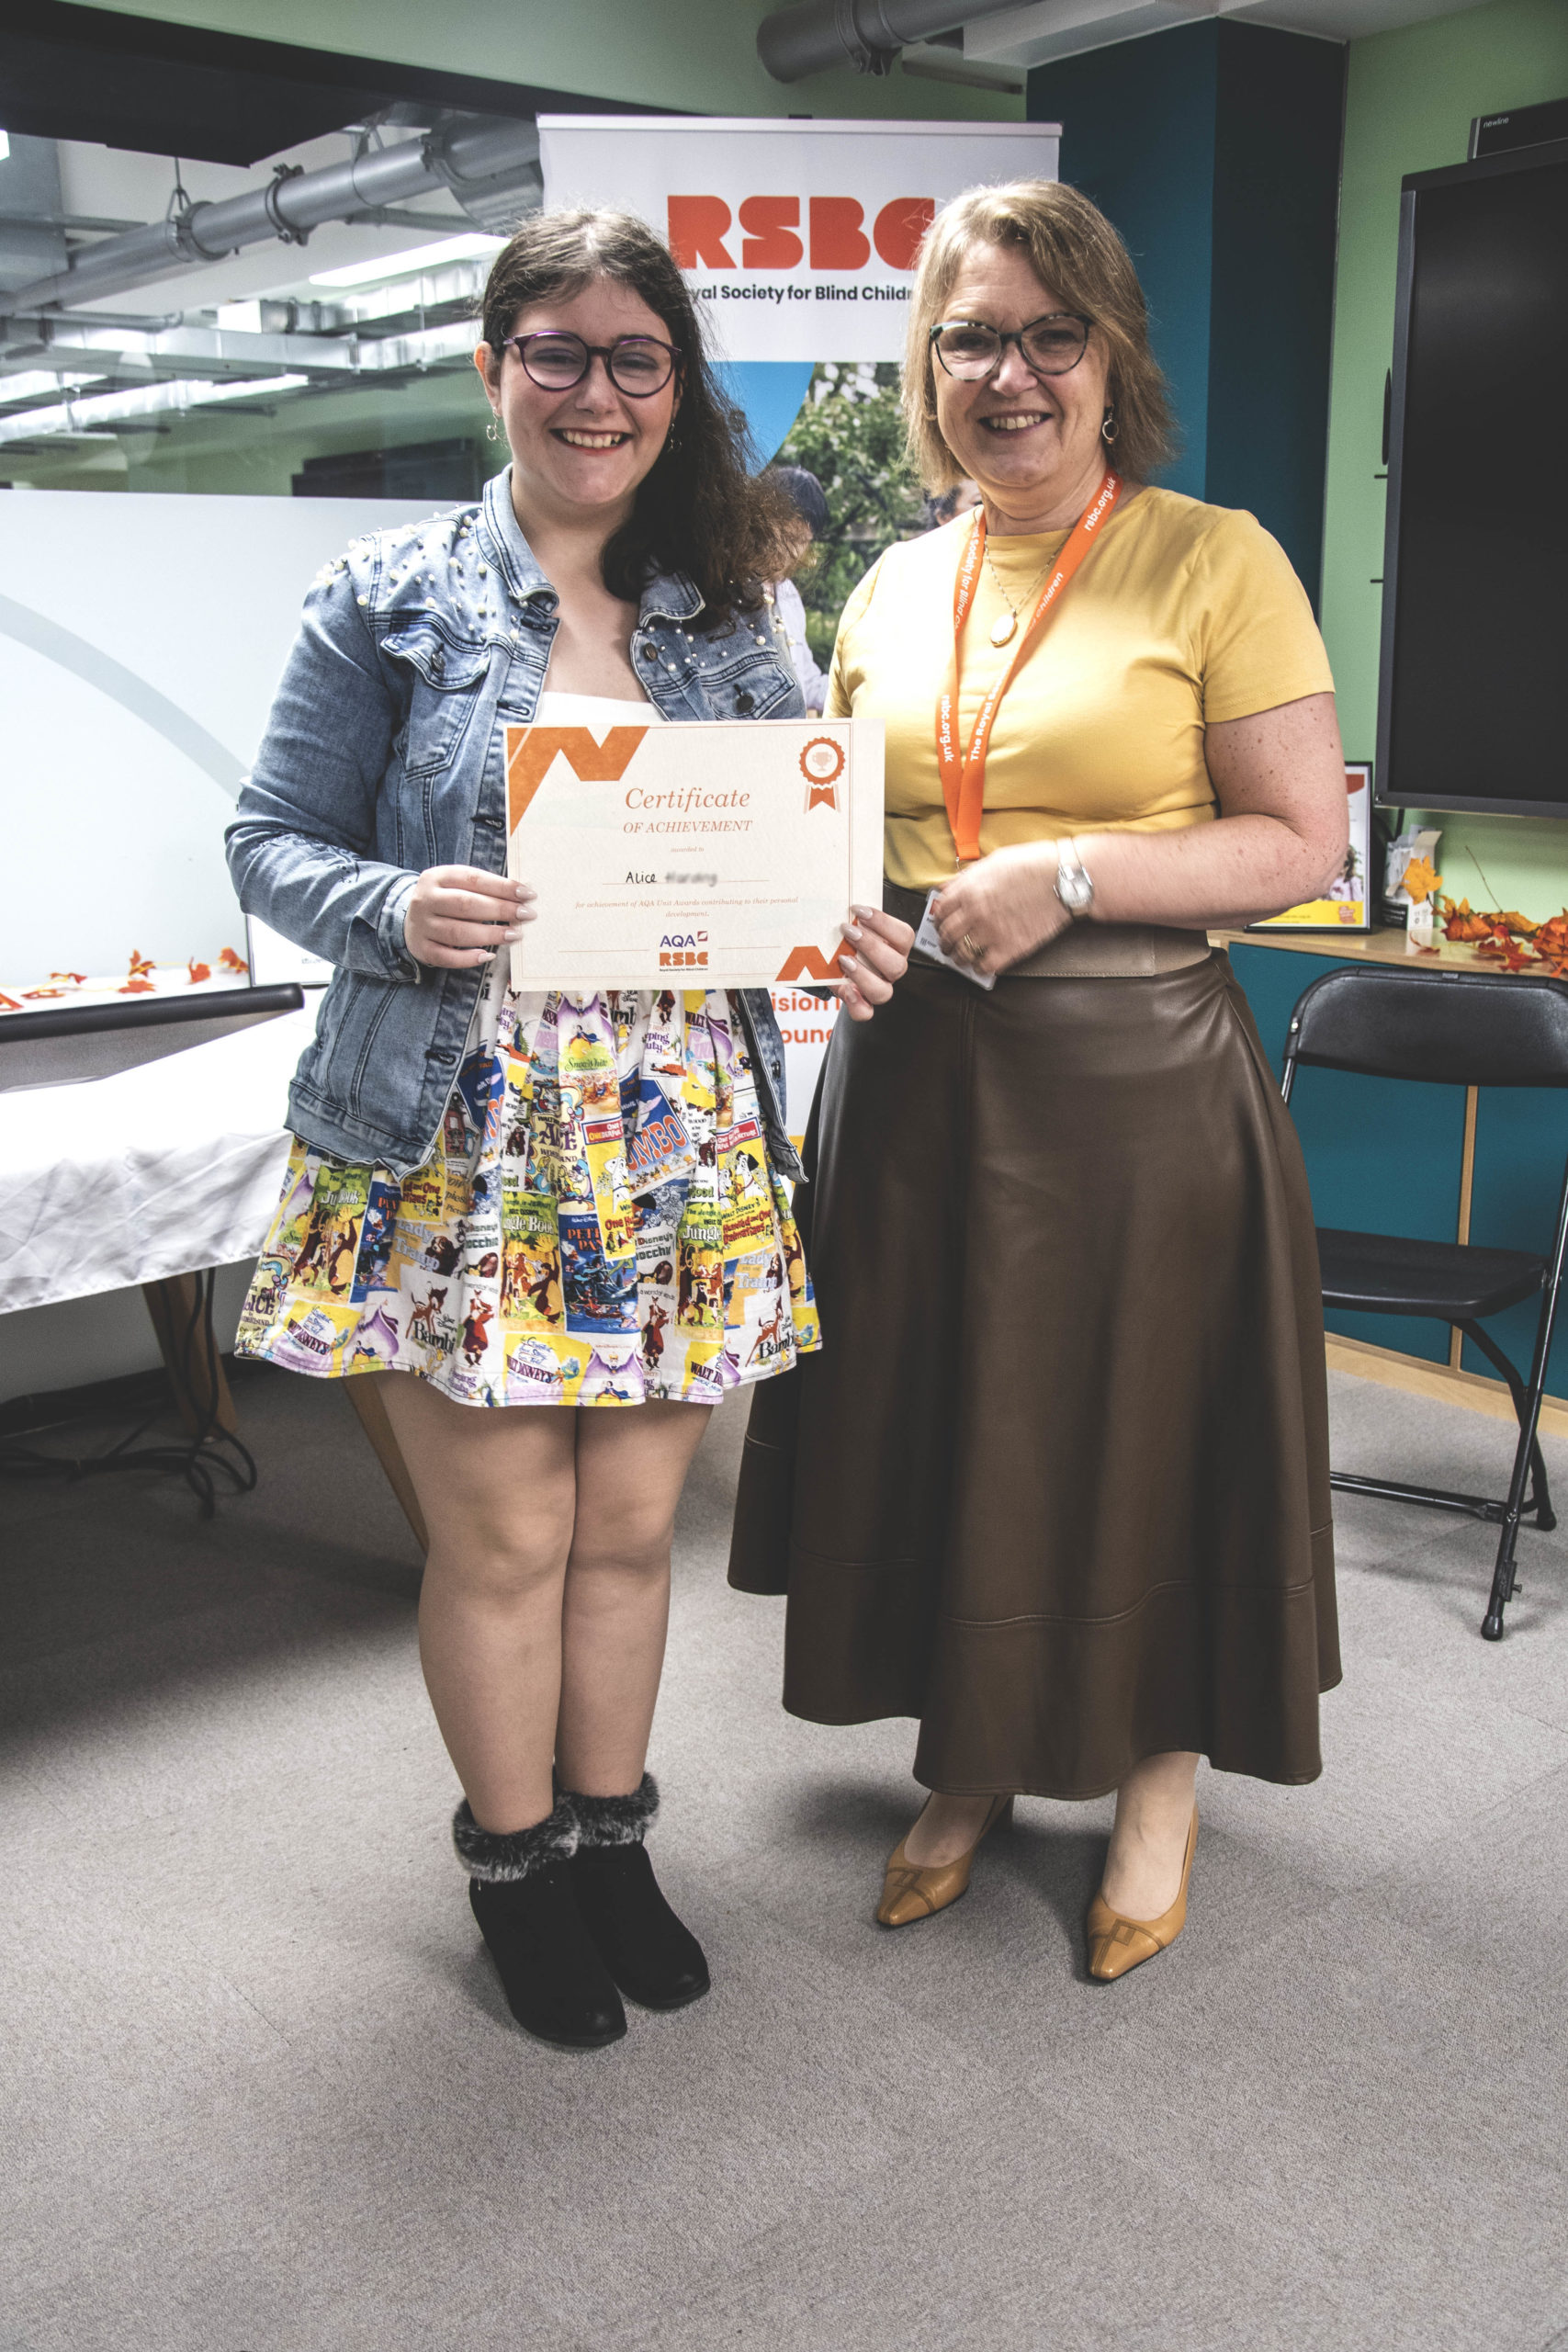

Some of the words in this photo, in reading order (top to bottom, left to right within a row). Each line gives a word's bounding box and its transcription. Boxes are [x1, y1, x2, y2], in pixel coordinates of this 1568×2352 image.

[1483, 117, 1509, 129] newline
[667, 196, 935, 271] RSBC
[694, 286, 716, 305] yal
[720, 284, 784, 304] Society
[787, 286, 812, 300] for
[815, 286, 858, 300] Blind
[864, 286, 911, 301] Childr
[1084, 477, 1116, 531] rsbc.org.uk
[940, 694, 955, 763] rsbc.org.uk
[970, 738, 982, 762] The
[976, 701, 993, 737] Royal
[625, 786, 750, 812] Certificate
[623, 821, 643, 833] OF
[646, 820, 752, 833] ACHIEVEMENT
[626, 871, 657, 884] Alice
[639, 899, 655, 908] AQA
[660, 934, 696, 947] AQA
[659, 952, 708, 967] RSBC
[772, 991, 829, 1012] ision
[645, 1032, 670, 1046] eping
[780, 1029, 833, 1044] oun
[626, 1114, 687, 1171] UMBO
[413, 1320, 457, 1355] Bambi
[760, 1330, 794, 1359] Bamb
[691, 1361, 714, 1380] WALT
